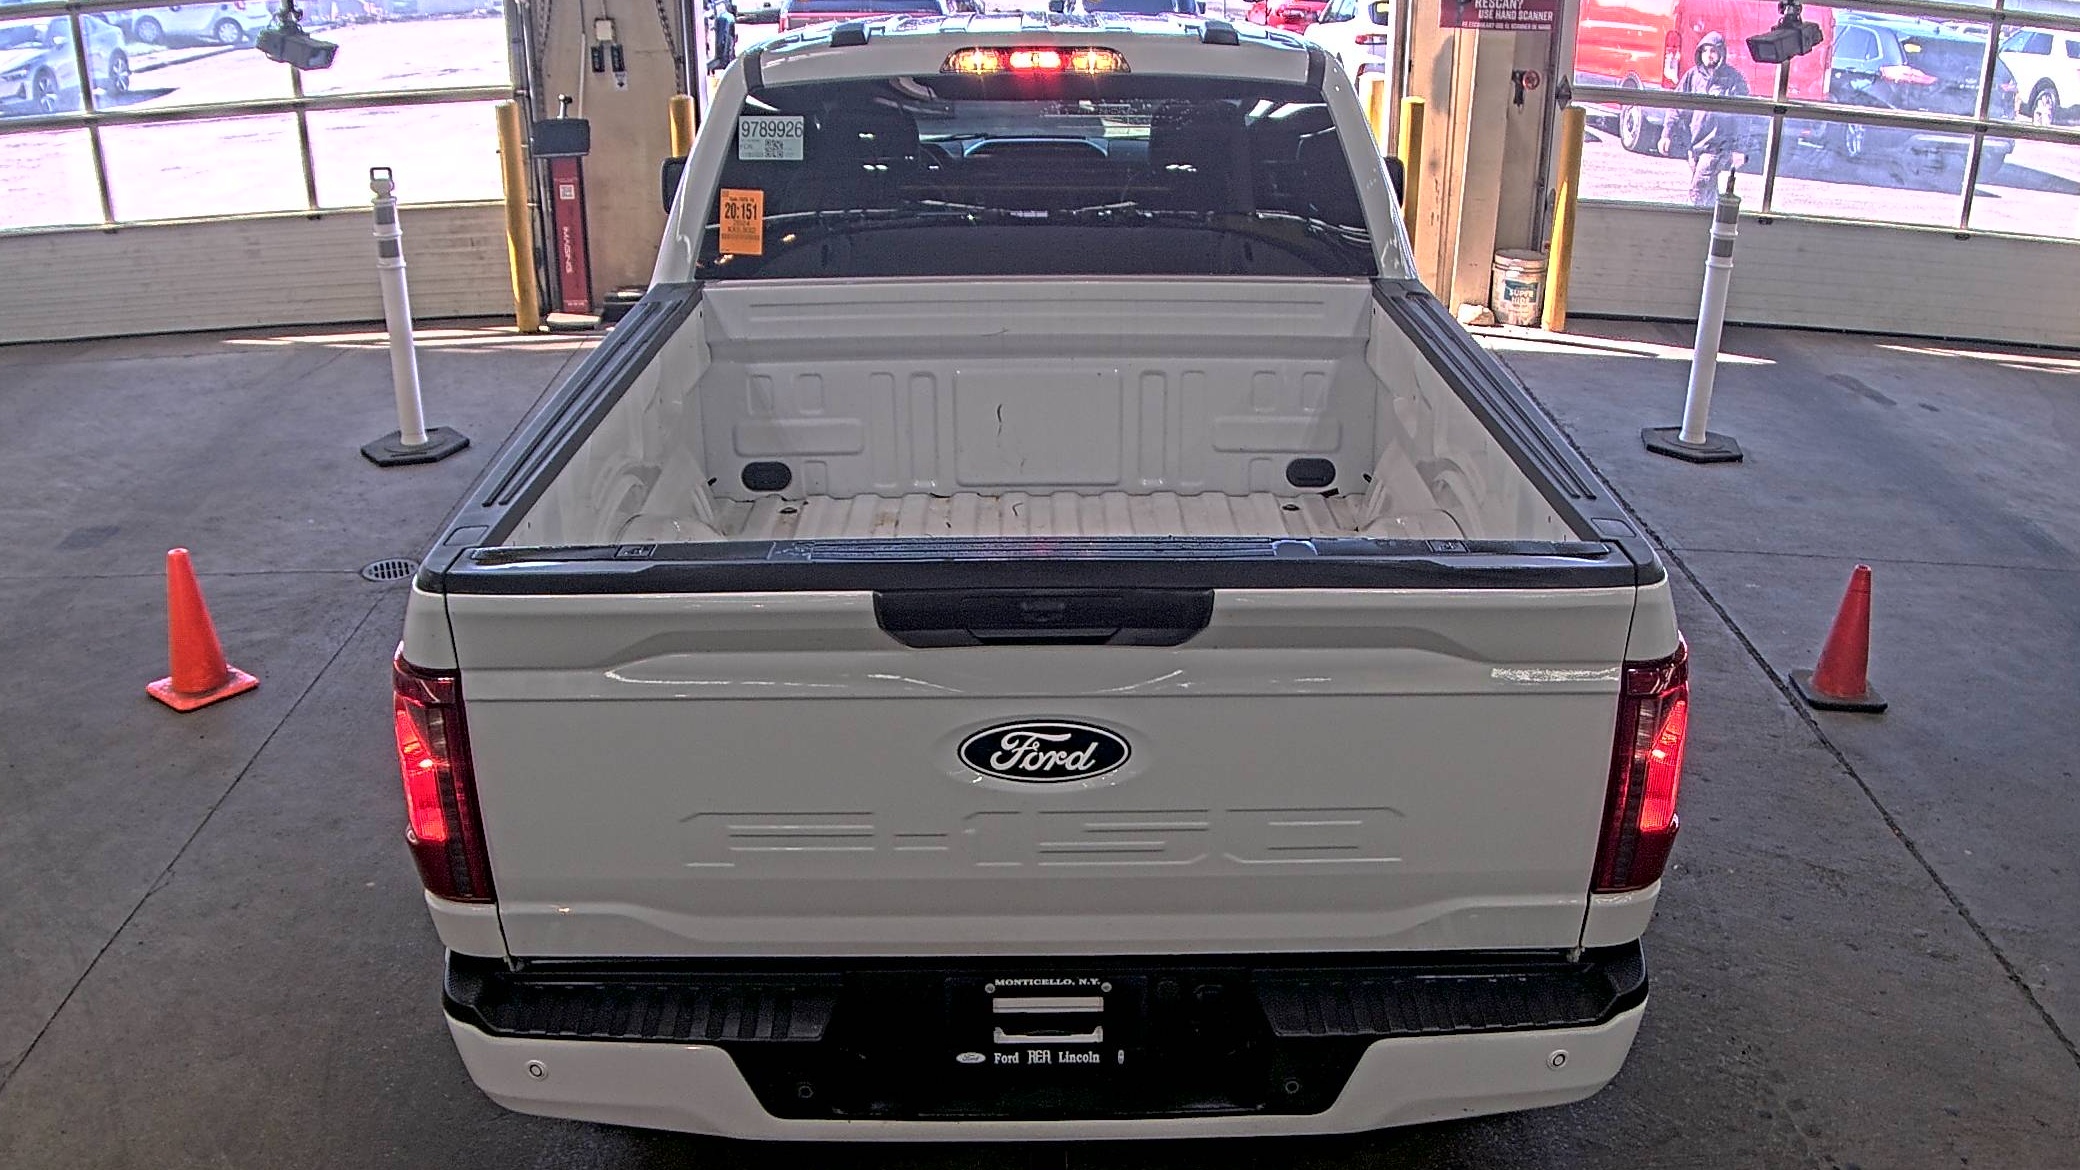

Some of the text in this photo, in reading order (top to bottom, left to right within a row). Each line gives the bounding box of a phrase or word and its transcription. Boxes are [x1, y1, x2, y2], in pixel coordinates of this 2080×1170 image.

[1478, 8, 1553, 21] USE HAND SCANNER
[741, 120, 804, 138] 9789926
[724, 202, 758, 220] 20:151
[990, 731, 1099, 771] Ford
[994, 978, 1101, 987] MONTICELLO, N.Y.
[994, 1052, 1019, 1064] Ford
[1058, 1051, 1100, 1064] Lincoln
